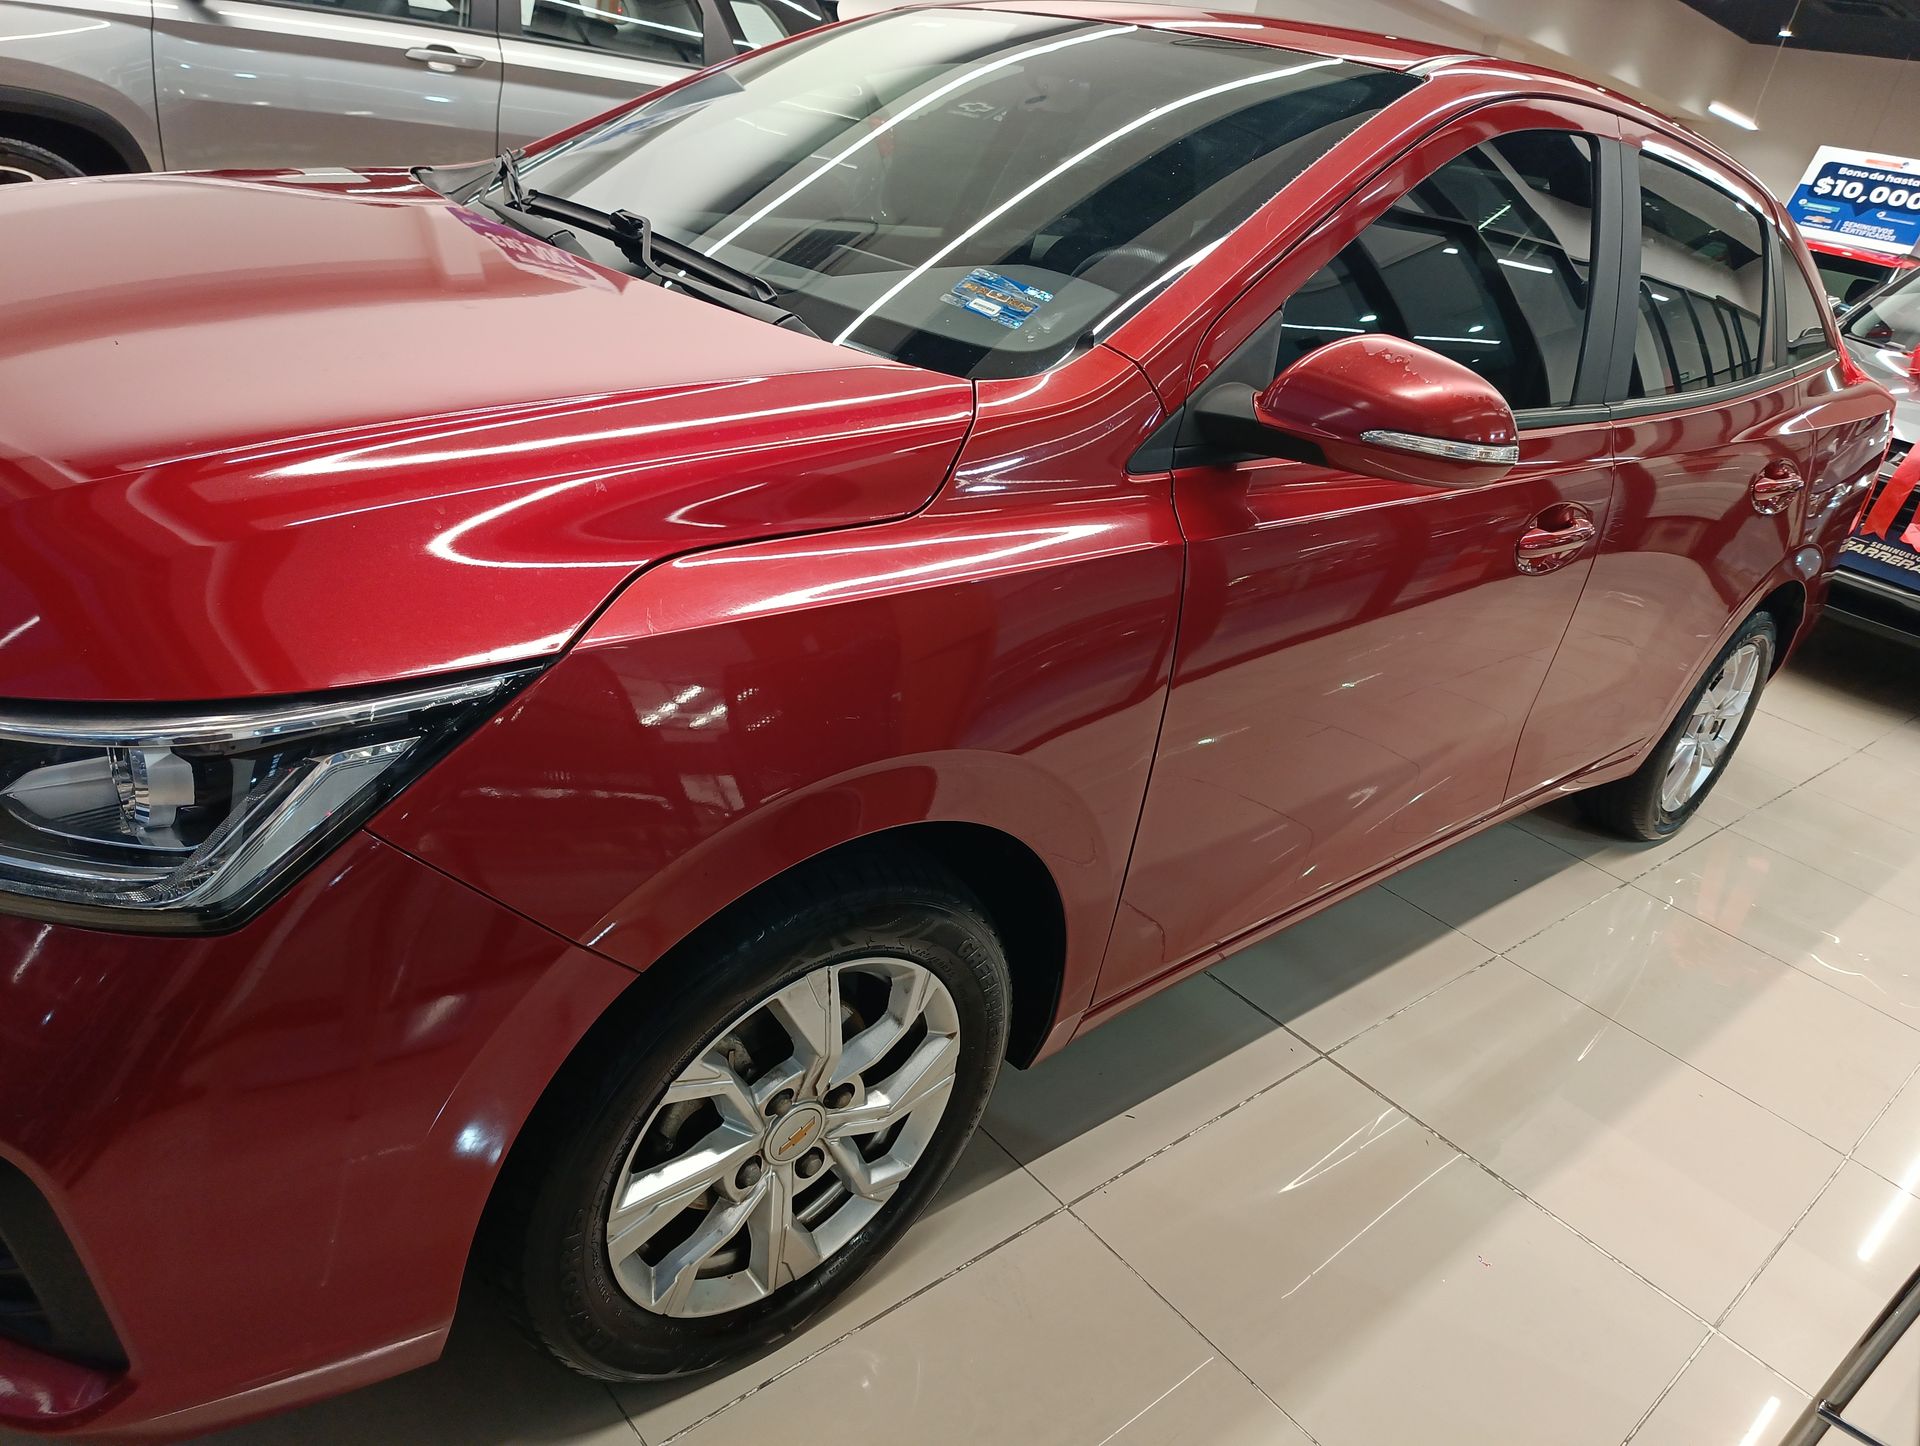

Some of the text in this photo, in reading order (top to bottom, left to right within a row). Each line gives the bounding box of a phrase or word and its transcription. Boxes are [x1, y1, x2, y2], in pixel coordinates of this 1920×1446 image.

[1838, 167, 1920, 187] Bono de hasta
[1813, 176, 1920, 210] $10,000
[1840, 226, 1897, 241] CERTIFICADOS
[1843, 220, 1895, 235] SEMINUEVOS
